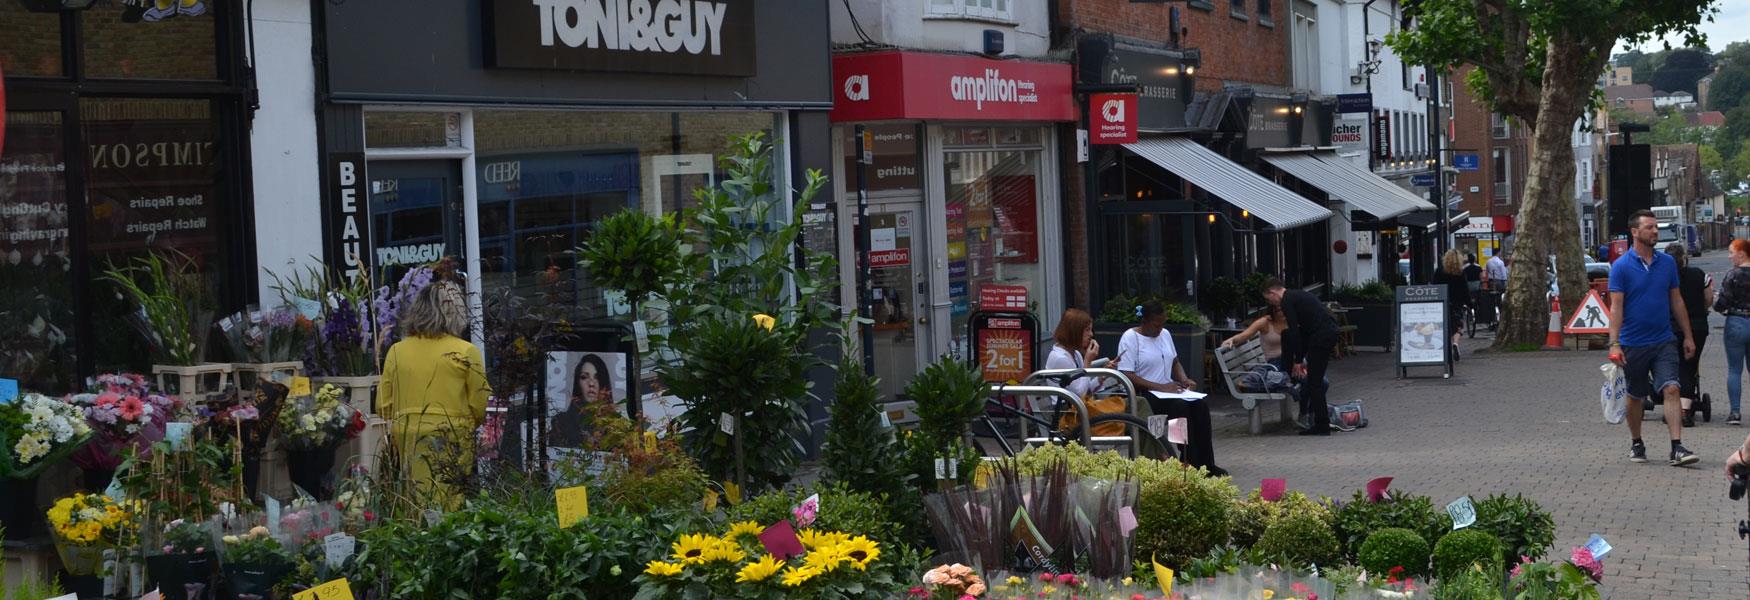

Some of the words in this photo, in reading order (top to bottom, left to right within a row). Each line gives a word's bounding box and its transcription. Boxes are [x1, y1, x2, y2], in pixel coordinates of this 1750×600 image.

[533, 0, 727, 55] TONI&GUY
[951, 68, 1018, 110] amplifon
[1017, 79, 1035, 92] Hearing
[1141, 85, 1177, 99] RASSERIE
[1018, 93, 1038, 104] specialist
[1101, 124, 1126, 132] Hearing
[1332, 123, 1361, 134] icher
[1099, 131, 1127, 140] specialist
[1332, 134, 1361, 142] OUNDS
[376, 243, 446, 266] TONI&GUY
[871, 251, 908, 264] amplifon
[1405, 286, 1440, 296] CÔTE
[986, 349, 998, 369] 2
[1000, 354, 1017, 367] for
